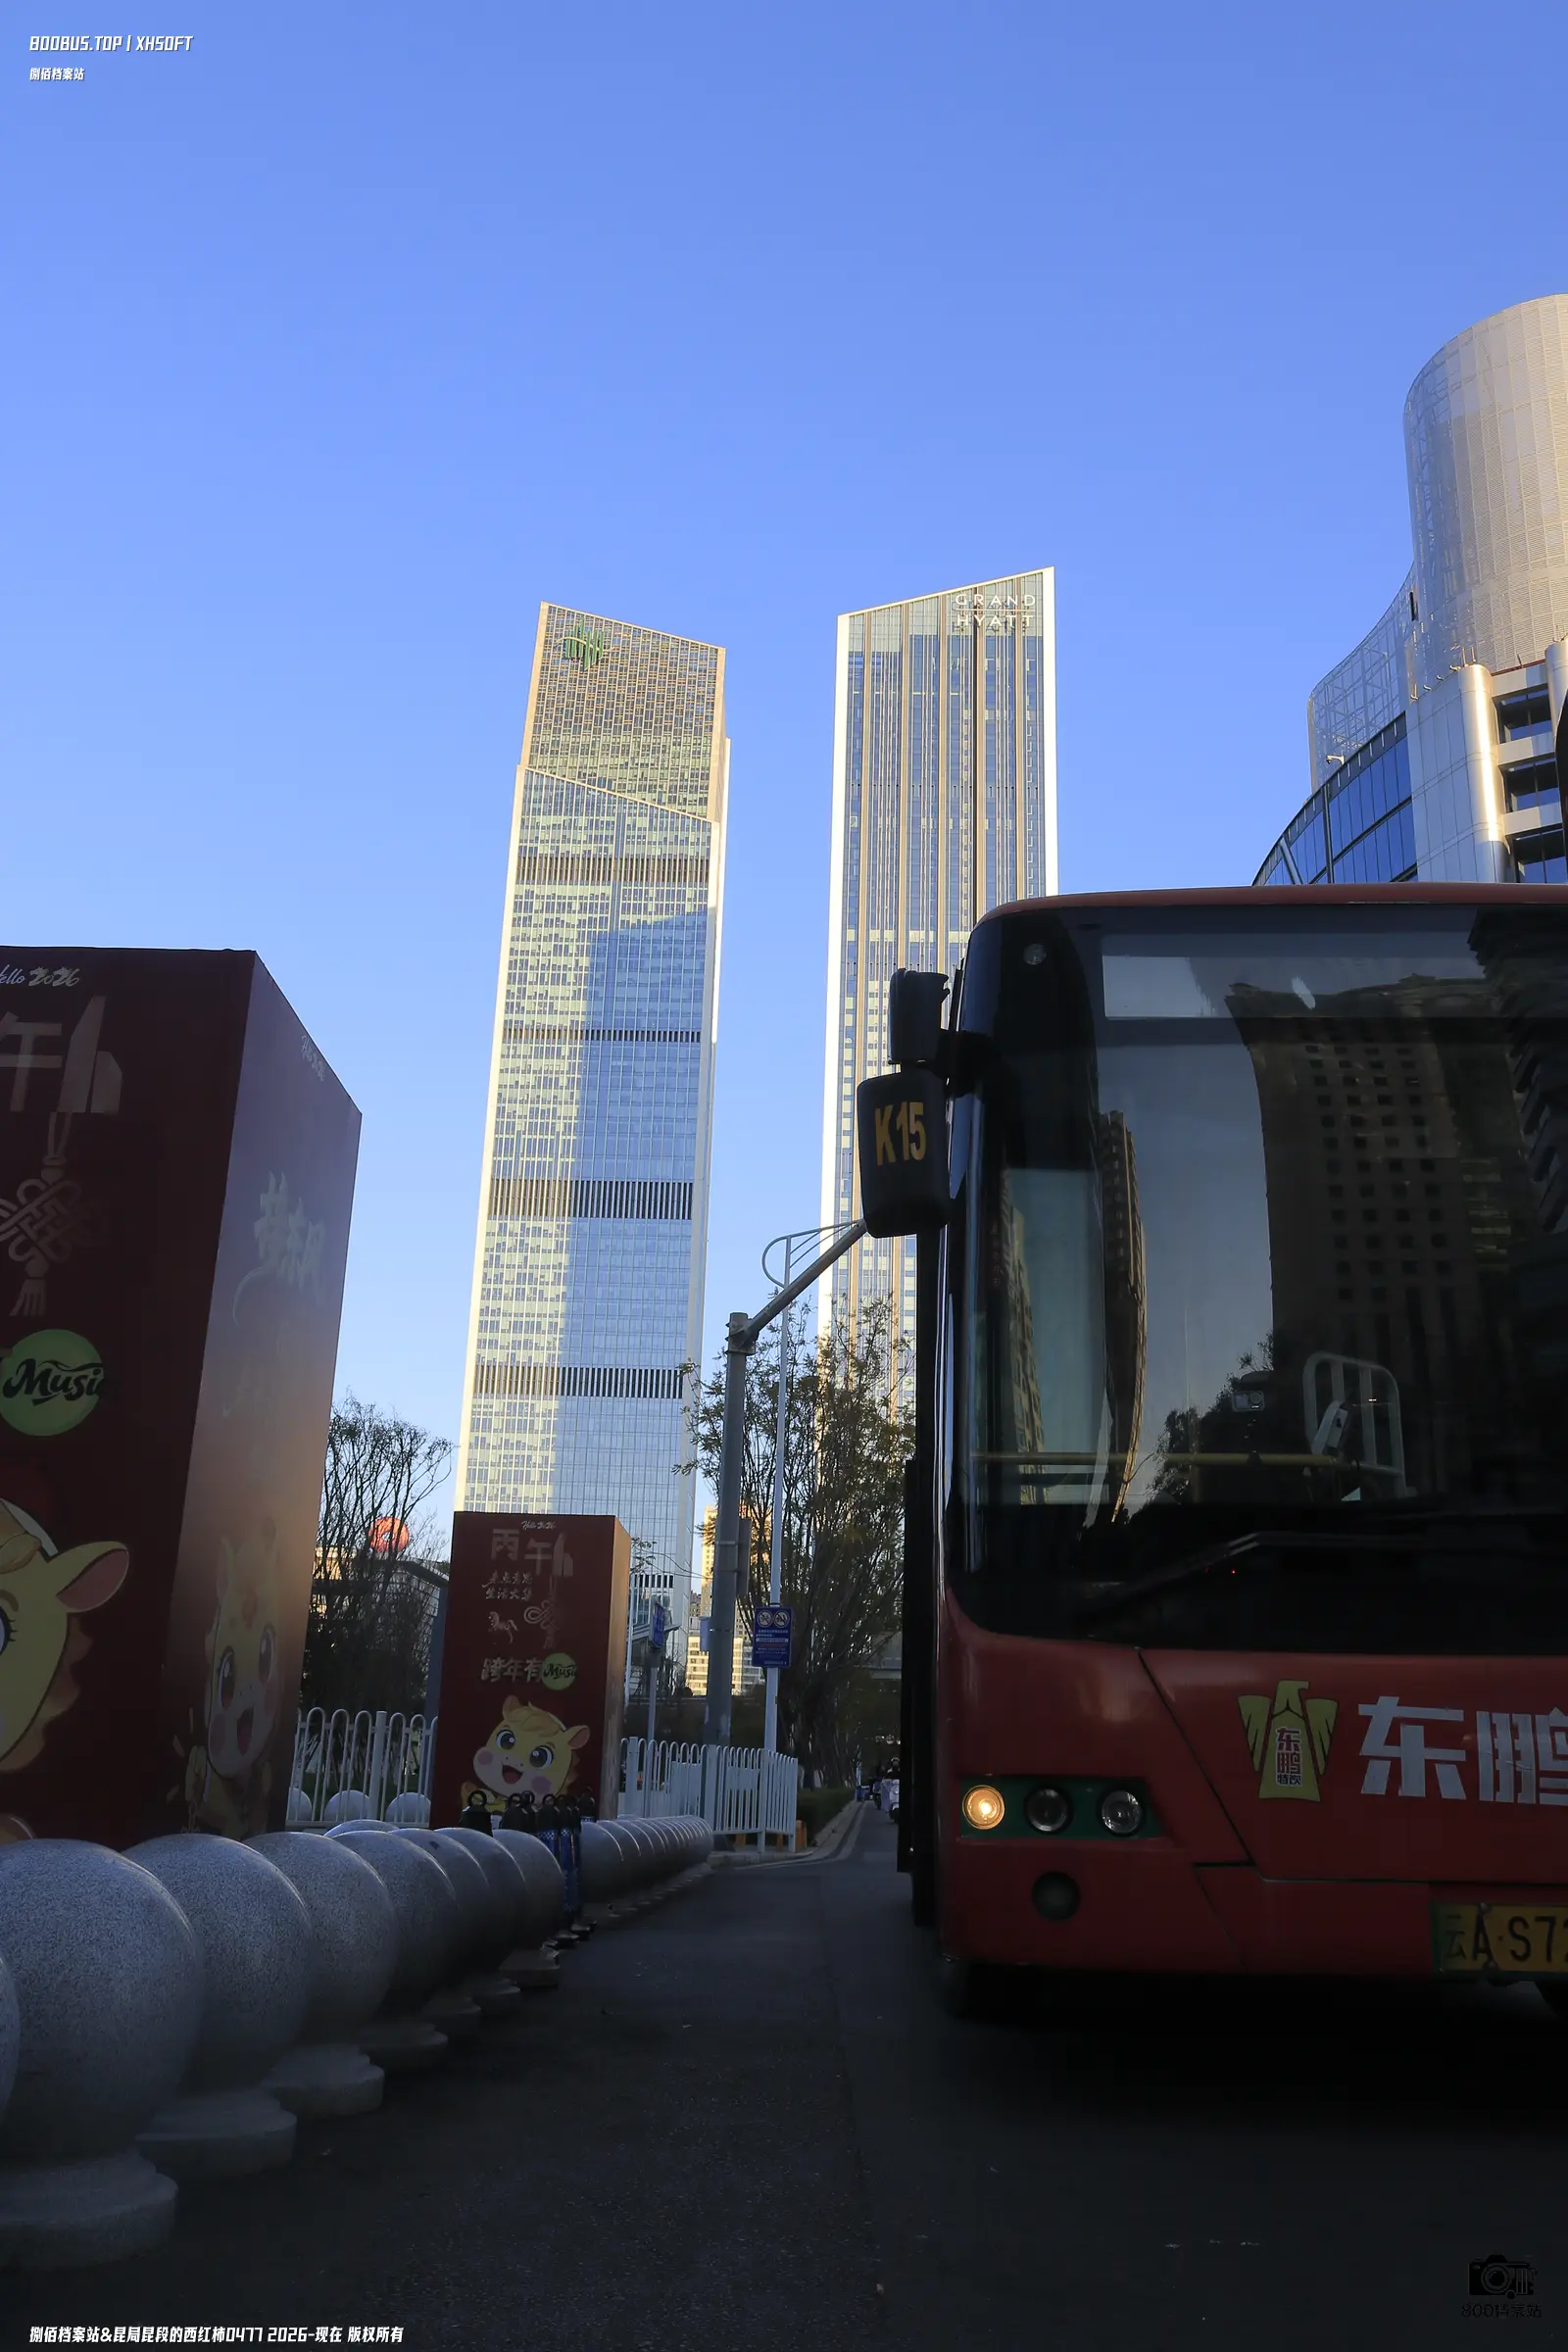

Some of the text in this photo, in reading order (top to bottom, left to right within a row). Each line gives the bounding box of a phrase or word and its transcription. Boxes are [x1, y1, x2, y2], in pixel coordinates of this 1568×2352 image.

[956, 593, 1036, 607] GRAND
[956, 614, 1034, 627] HYATT
[0, 963, 81, 988] ello 2026
[874, 1101, 926, 1166] K15
[1275, 1727, 1301, 1775] 东鹏
[1358, 1696, 1568, 1806] 东鹏
[1446, 1909, 1568, 1963] 云A·S7
